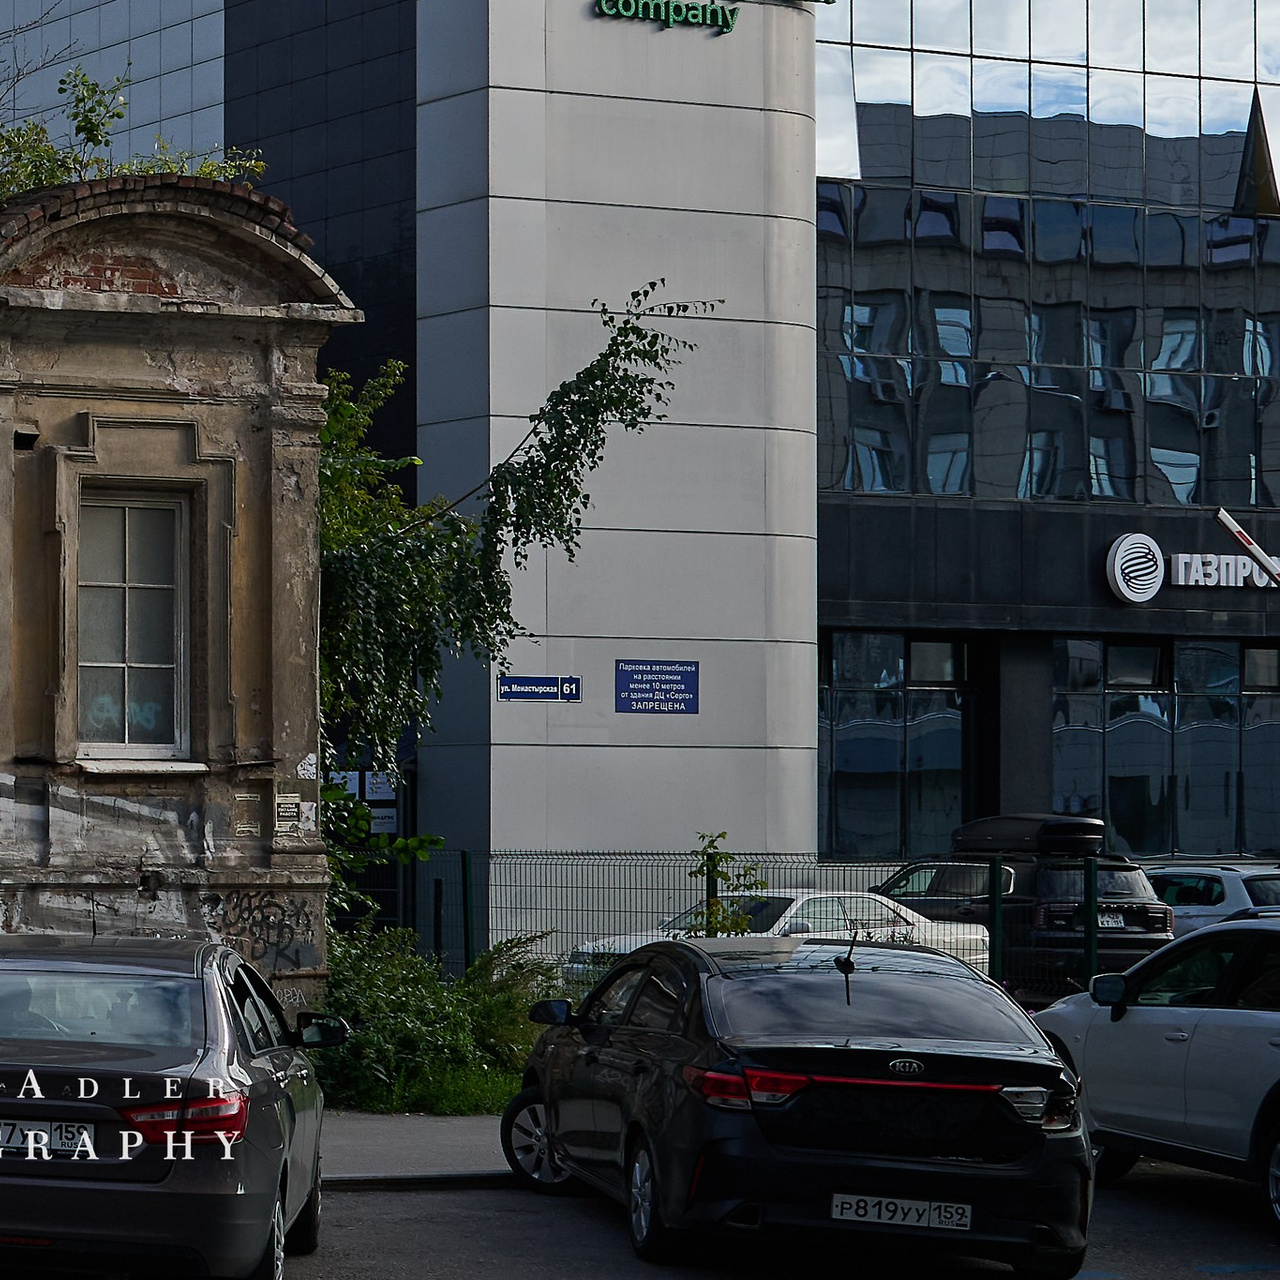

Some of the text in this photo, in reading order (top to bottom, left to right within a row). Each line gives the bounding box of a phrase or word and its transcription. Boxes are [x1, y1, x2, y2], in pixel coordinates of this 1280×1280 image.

[1172, 553, 1280, 588] ГАЗПРО
[619, 663, 696, 672] Парковка автомобилей
[500, 683, 576, 694] ул. Монастырская 61
[653, 691, 665, 700] ДЦ
[666, 691, 693, 700] «Серго»
[631, 701, 686, 711] ЗАПРЕЩЕНА
[895, 1062, 919, 1073] KIA
[933, 1204, 966, 1221] 159
[938, 1219, 956, 1227] RUS
